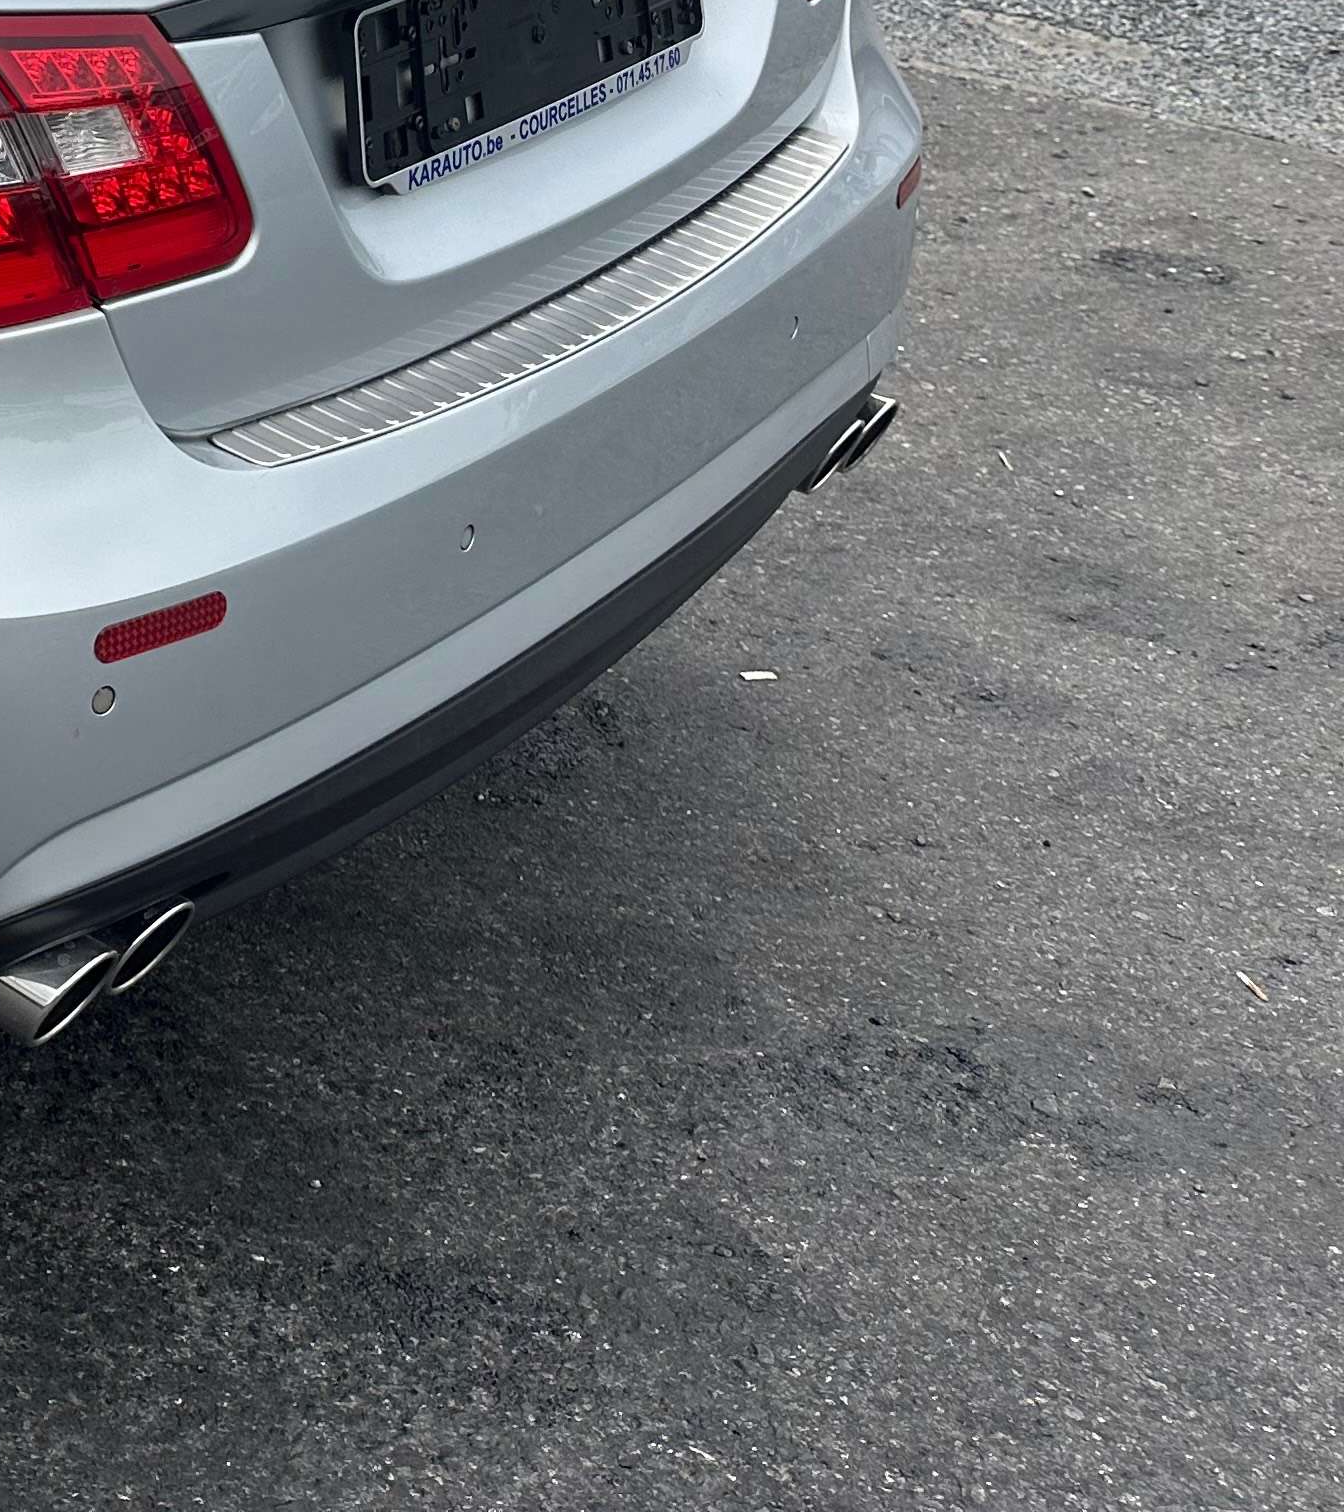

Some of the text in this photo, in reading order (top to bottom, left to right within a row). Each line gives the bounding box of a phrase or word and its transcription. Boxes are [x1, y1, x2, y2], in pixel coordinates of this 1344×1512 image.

[408, 134, 504, 190] KARAUTO.be
[519, 83, 607, 140] COURCELLES
[616, 47, 681, 93] 071.45.17.60
